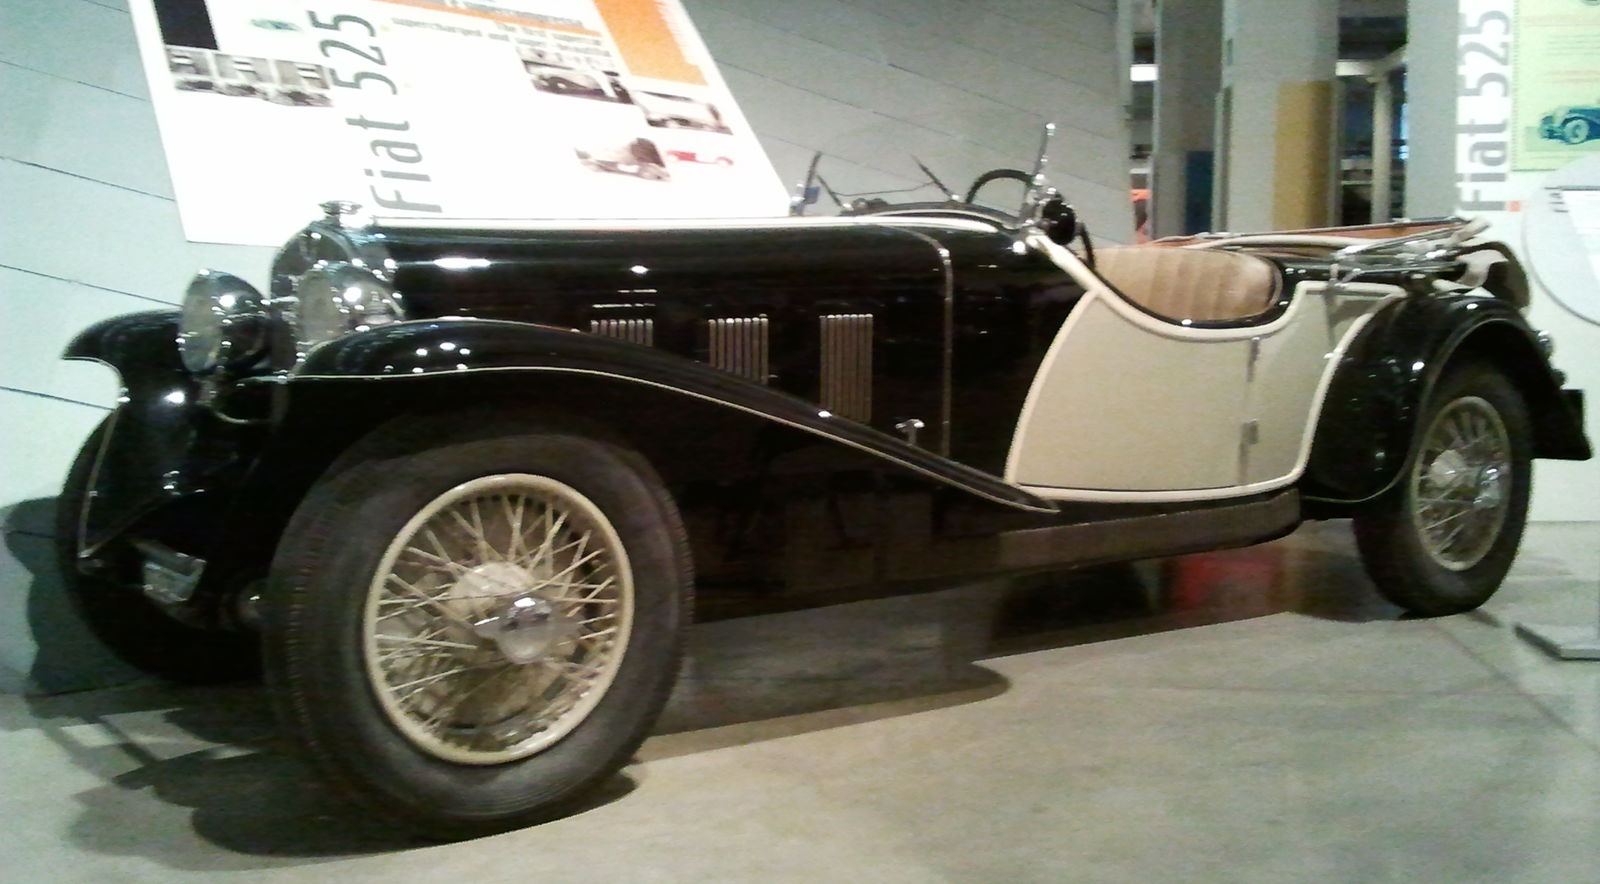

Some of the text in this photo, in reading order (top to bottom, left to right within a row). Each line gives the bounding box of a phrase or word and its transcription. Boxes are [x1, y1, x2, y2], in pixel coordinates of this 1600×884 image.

[307, 10, 443, 214] Fiat 525
[1457, 10, 1510, 211] Fiat 525
